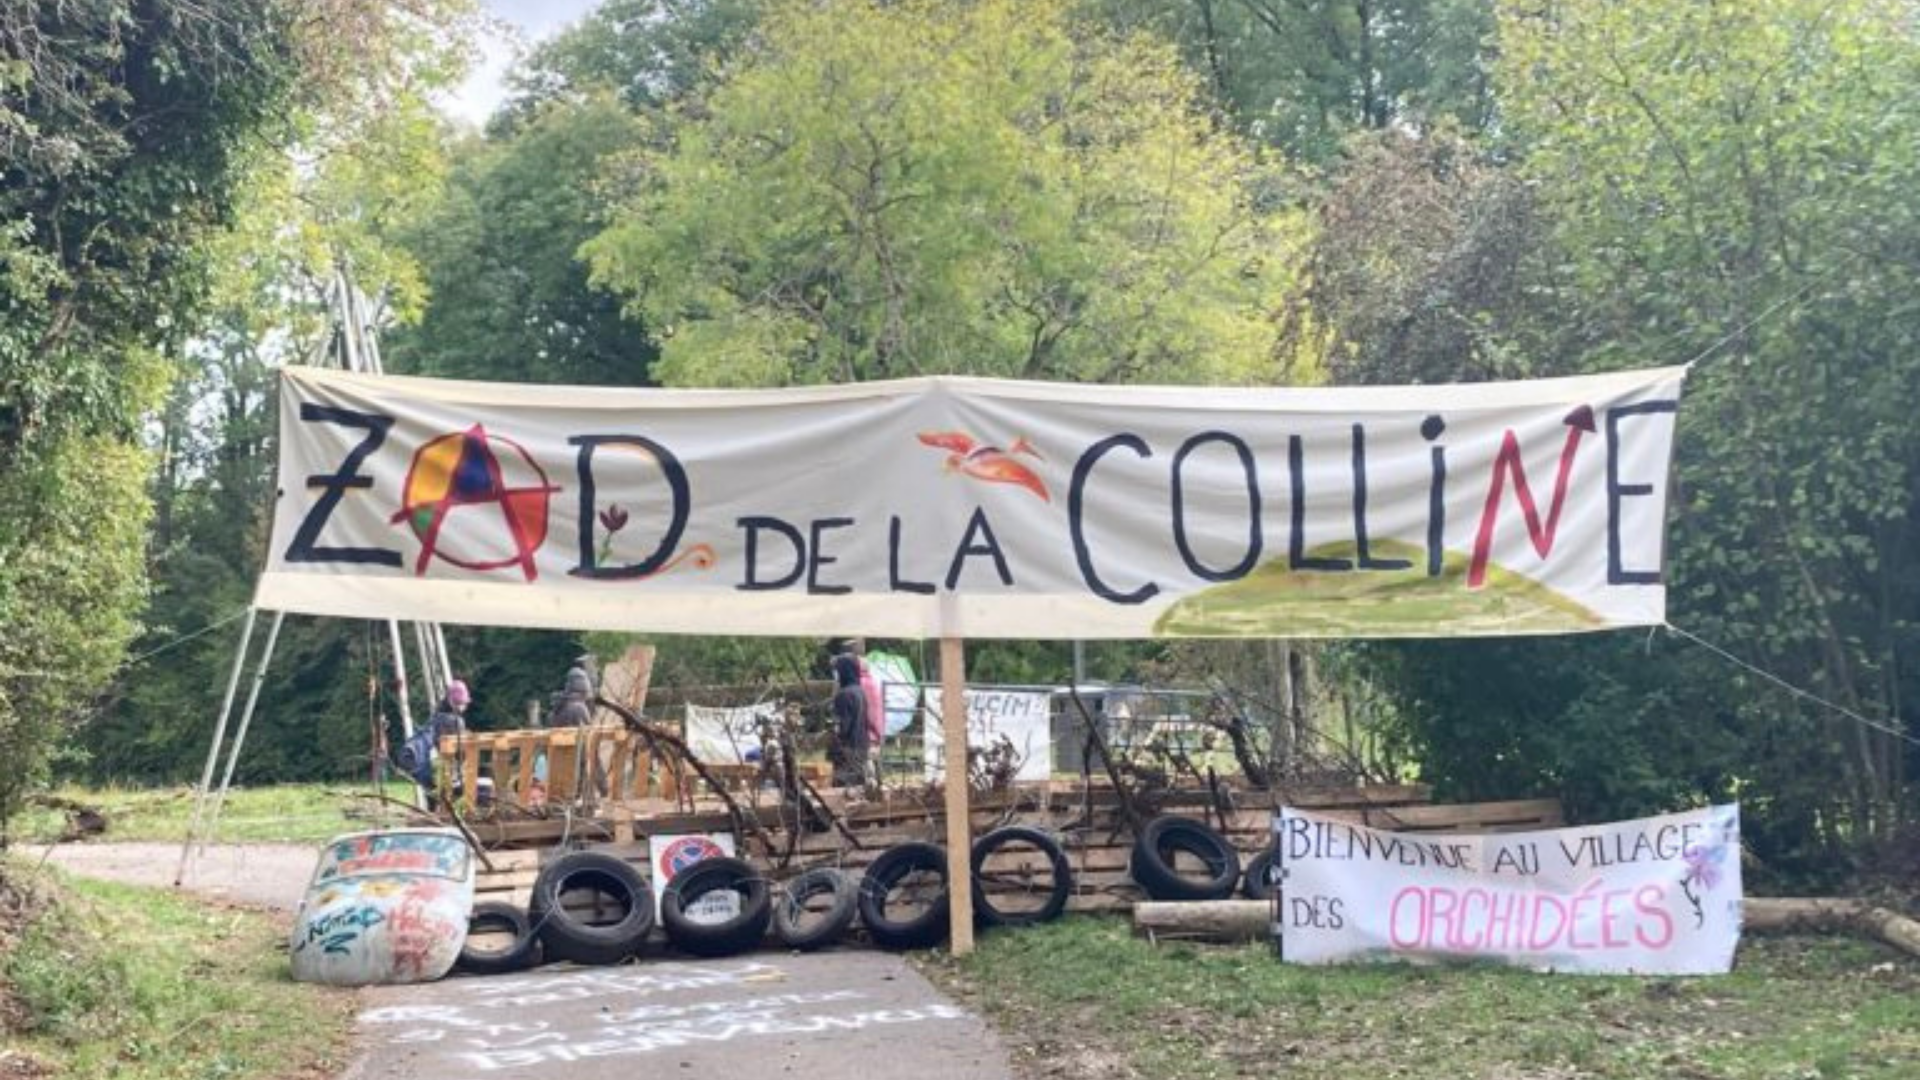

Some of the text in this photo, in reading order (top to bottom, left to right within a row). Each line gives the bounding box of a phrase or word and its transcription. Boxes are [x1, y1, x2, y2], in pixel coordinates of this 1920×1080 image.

[284, 402, 692, 583] ZAD
[735, 515, 855, 595] DE
[888, 505, 1014, 594] LA
[1288, 817, 1702, 876] BIENVENUE AU VILLAGE
[1291, 881, 1674, 952] DES ORCHIDÉES
